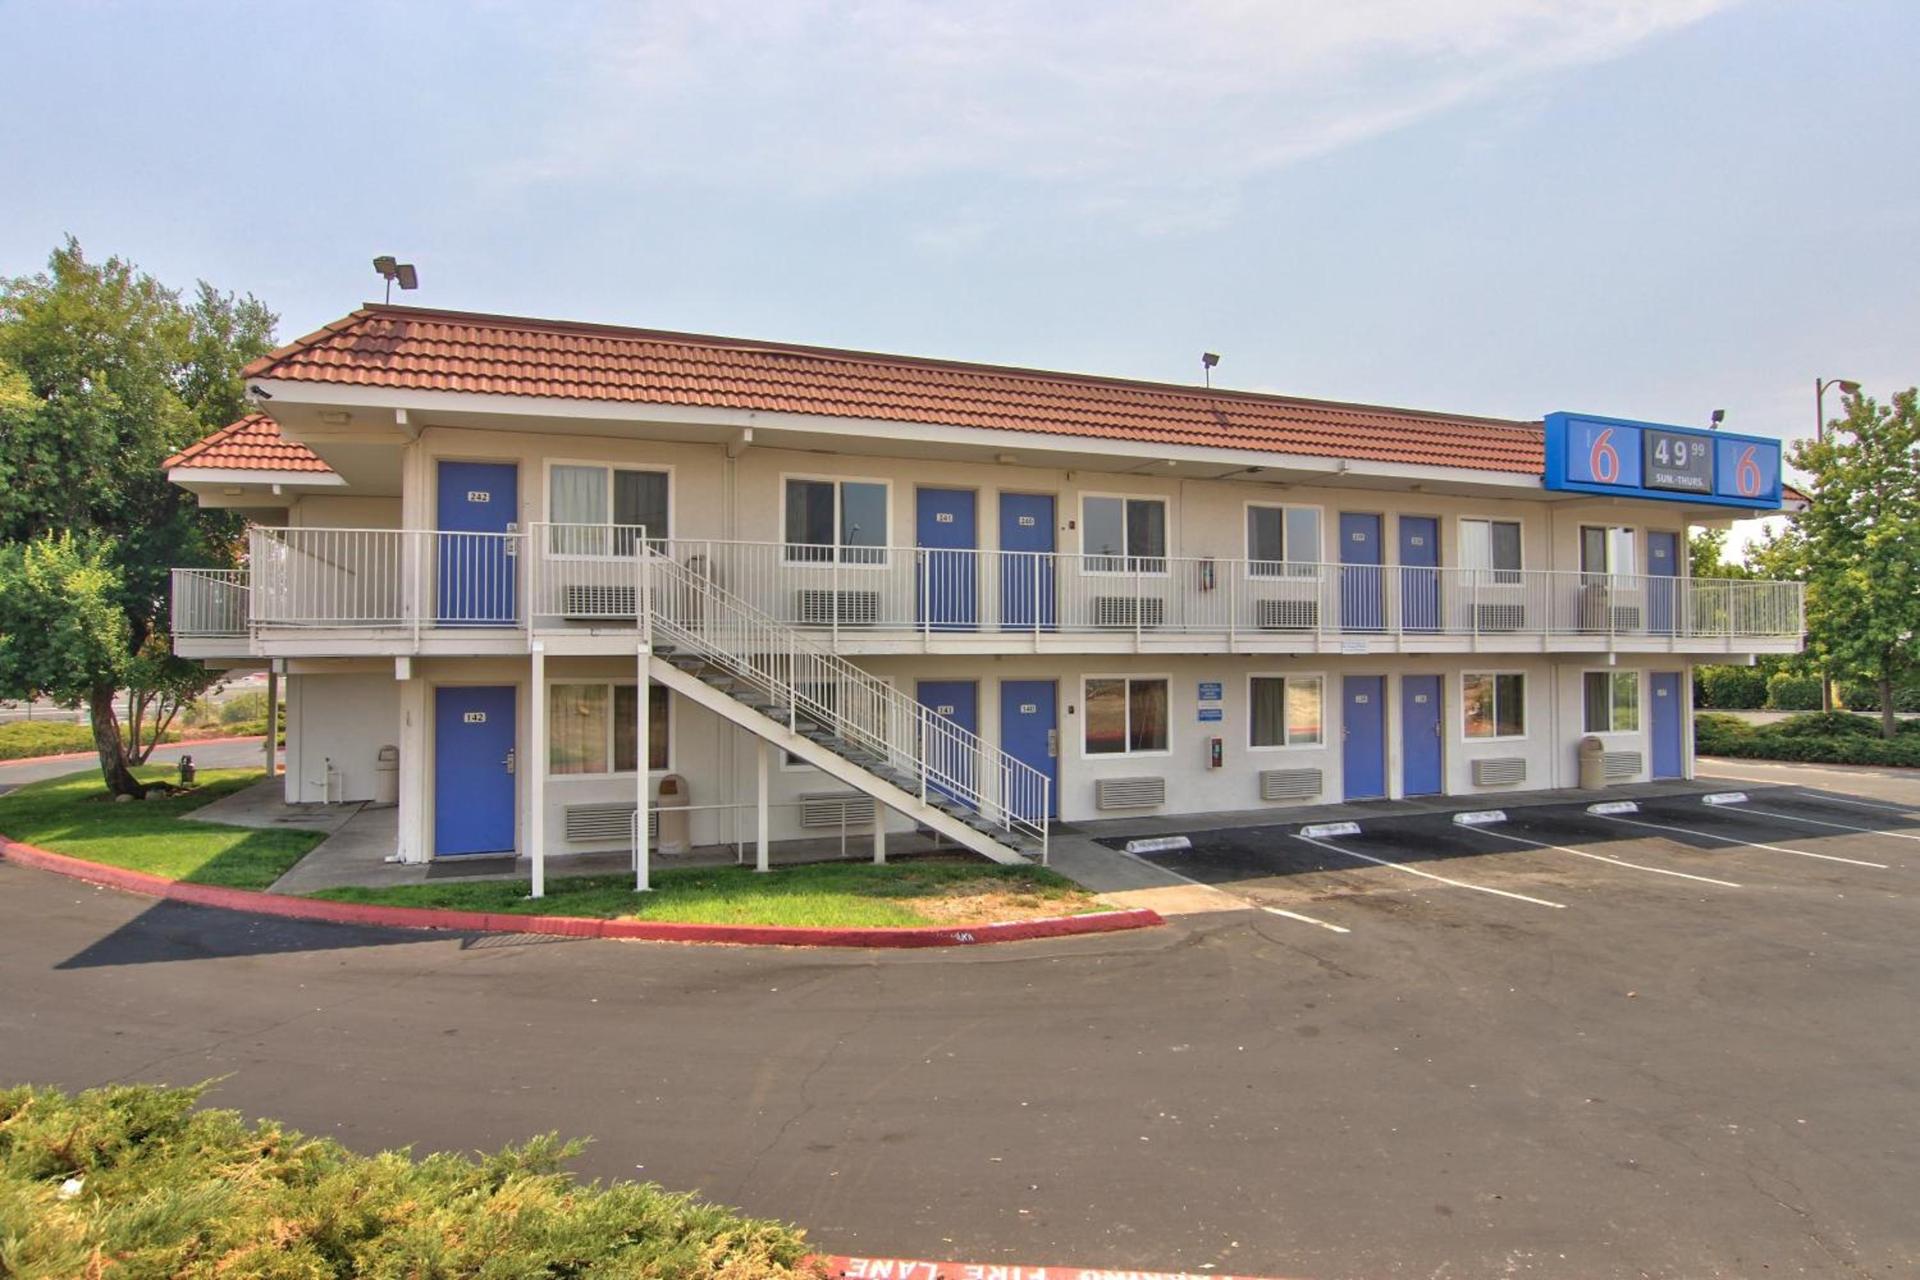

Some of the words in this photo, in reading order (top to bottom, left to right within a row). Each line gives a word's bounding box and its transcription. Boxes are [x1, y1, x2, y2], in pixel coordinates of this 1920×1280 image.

[1590, 428, 1620, 484] 6
[1655, 439, 1687, 466] 49
[1735, 446, 1761, 498] 6
[470, 492, 488, 502] 242
[466, 713, 484, 722] 142
[844, 1257, 938, 1280] LANE
[964, 1264, 1046, 1280] FIRE
